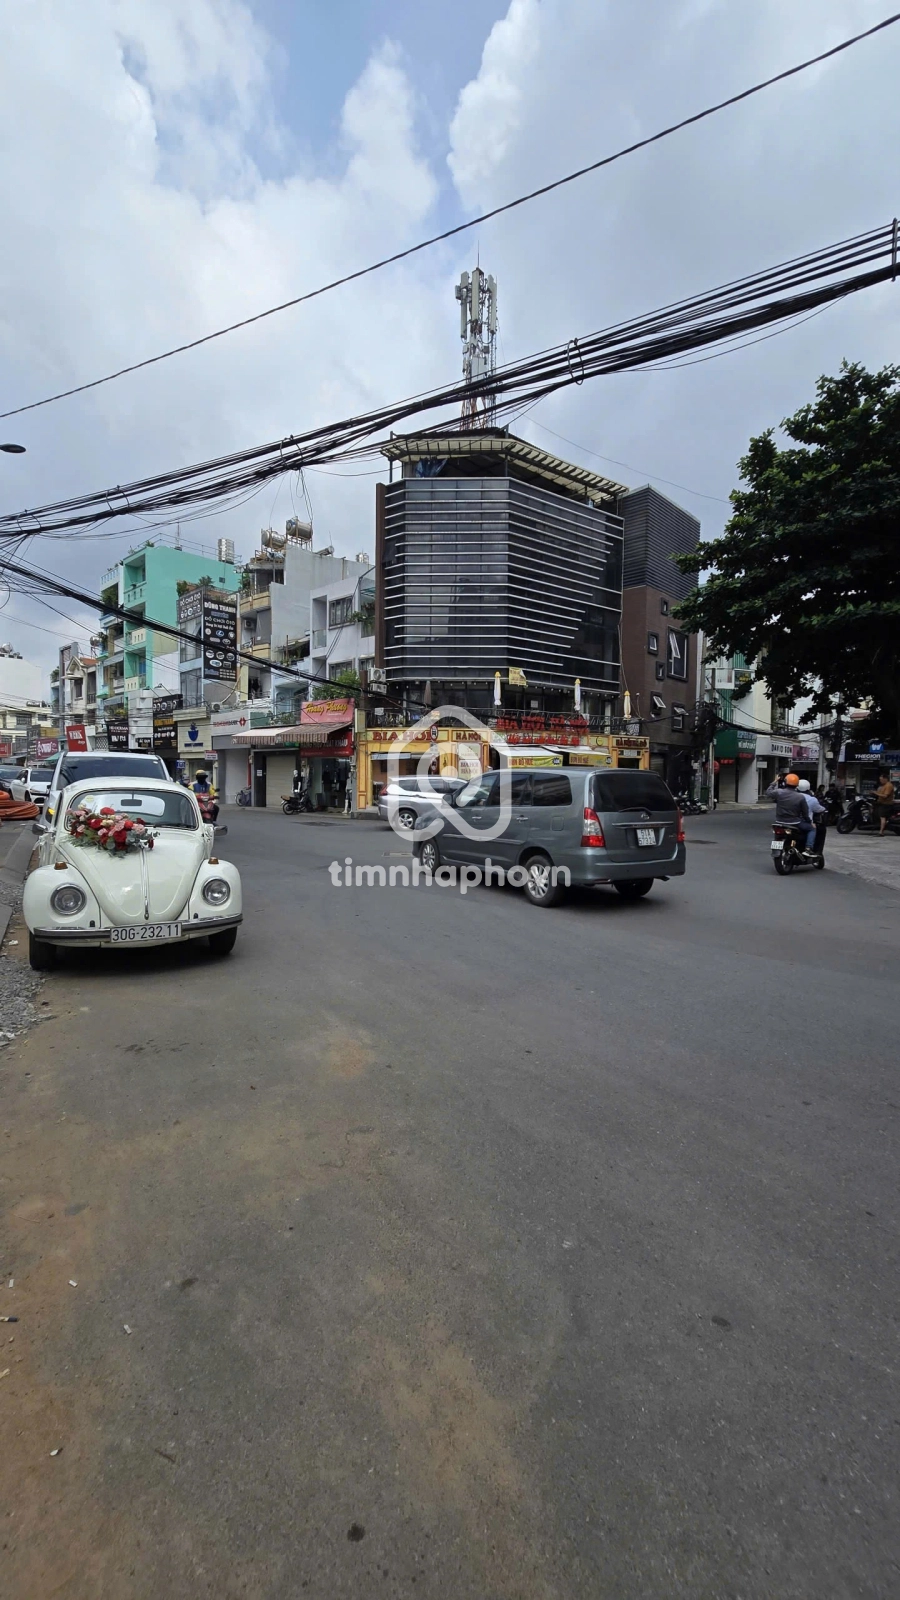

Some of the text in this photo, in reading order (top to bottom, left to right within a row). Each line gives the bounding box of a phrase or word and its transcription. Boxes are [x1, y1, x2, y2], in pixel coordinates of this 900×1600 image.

[373, 731, 400, 740] BIA
[456, 730, 468, 740] HÀ
[772, 744, 783, 752] DAVID
[112, 924, 179, 941] 30G-232.11
